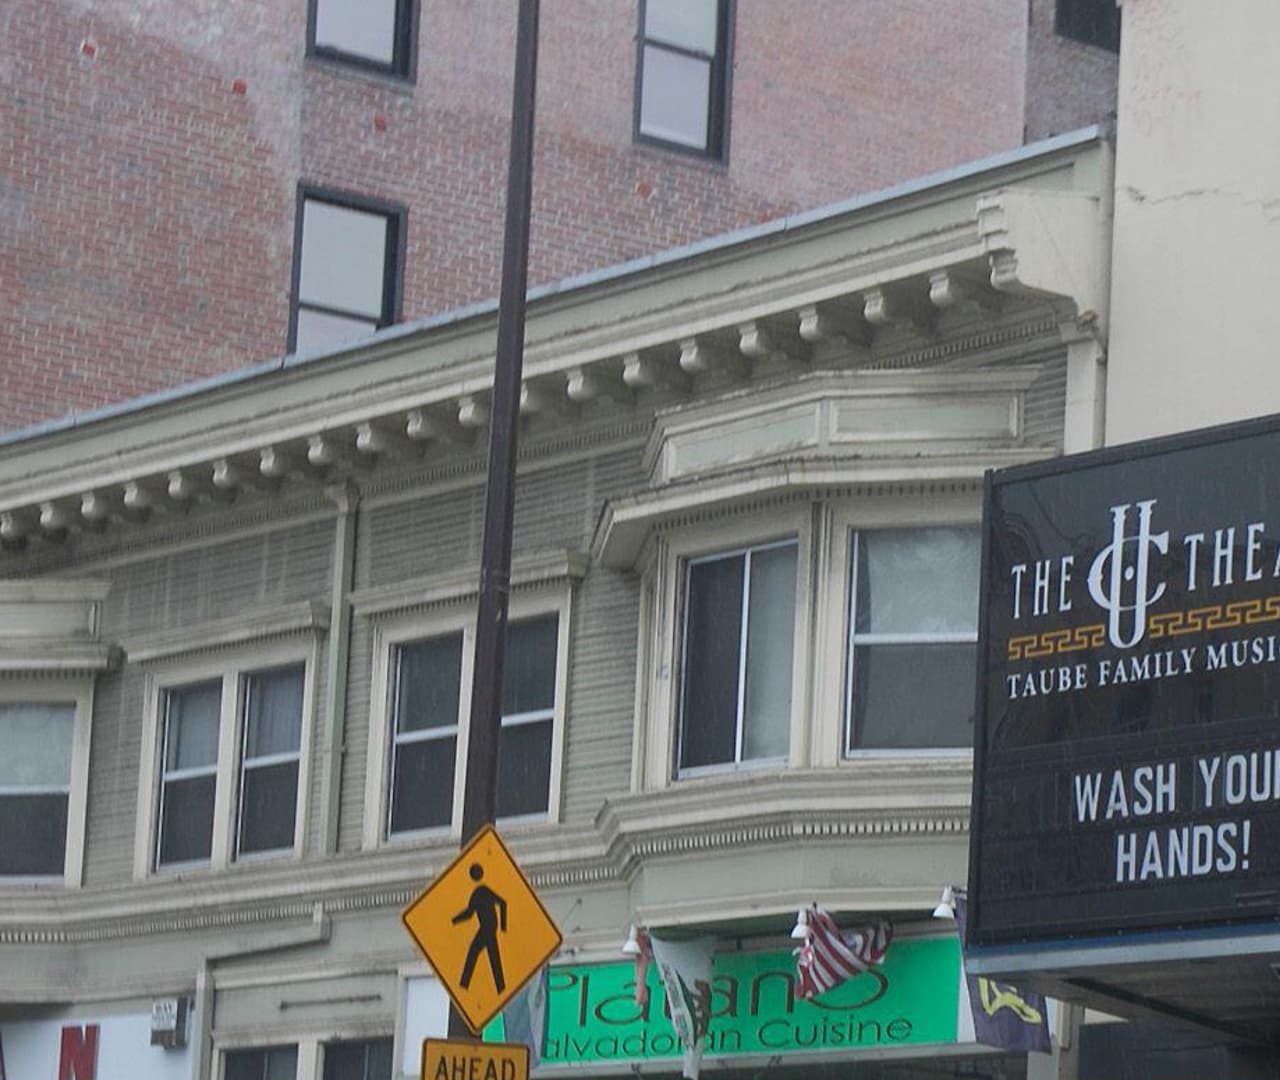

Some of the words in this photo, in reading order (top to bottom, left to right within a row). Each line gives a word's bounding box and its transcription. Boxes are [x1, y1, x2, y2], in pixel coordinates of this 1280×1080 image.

[1011, 556, 1074, 619] THE
[1006, 663, 1088, 699] TAUBE
[1099, 647, 1197, 687] FAMILY
[1074, 762, 1177, 823] WASH
[1116, 820, 1251, 883] HANDS!
[758, 1014, 913, 1047] Cuisine
